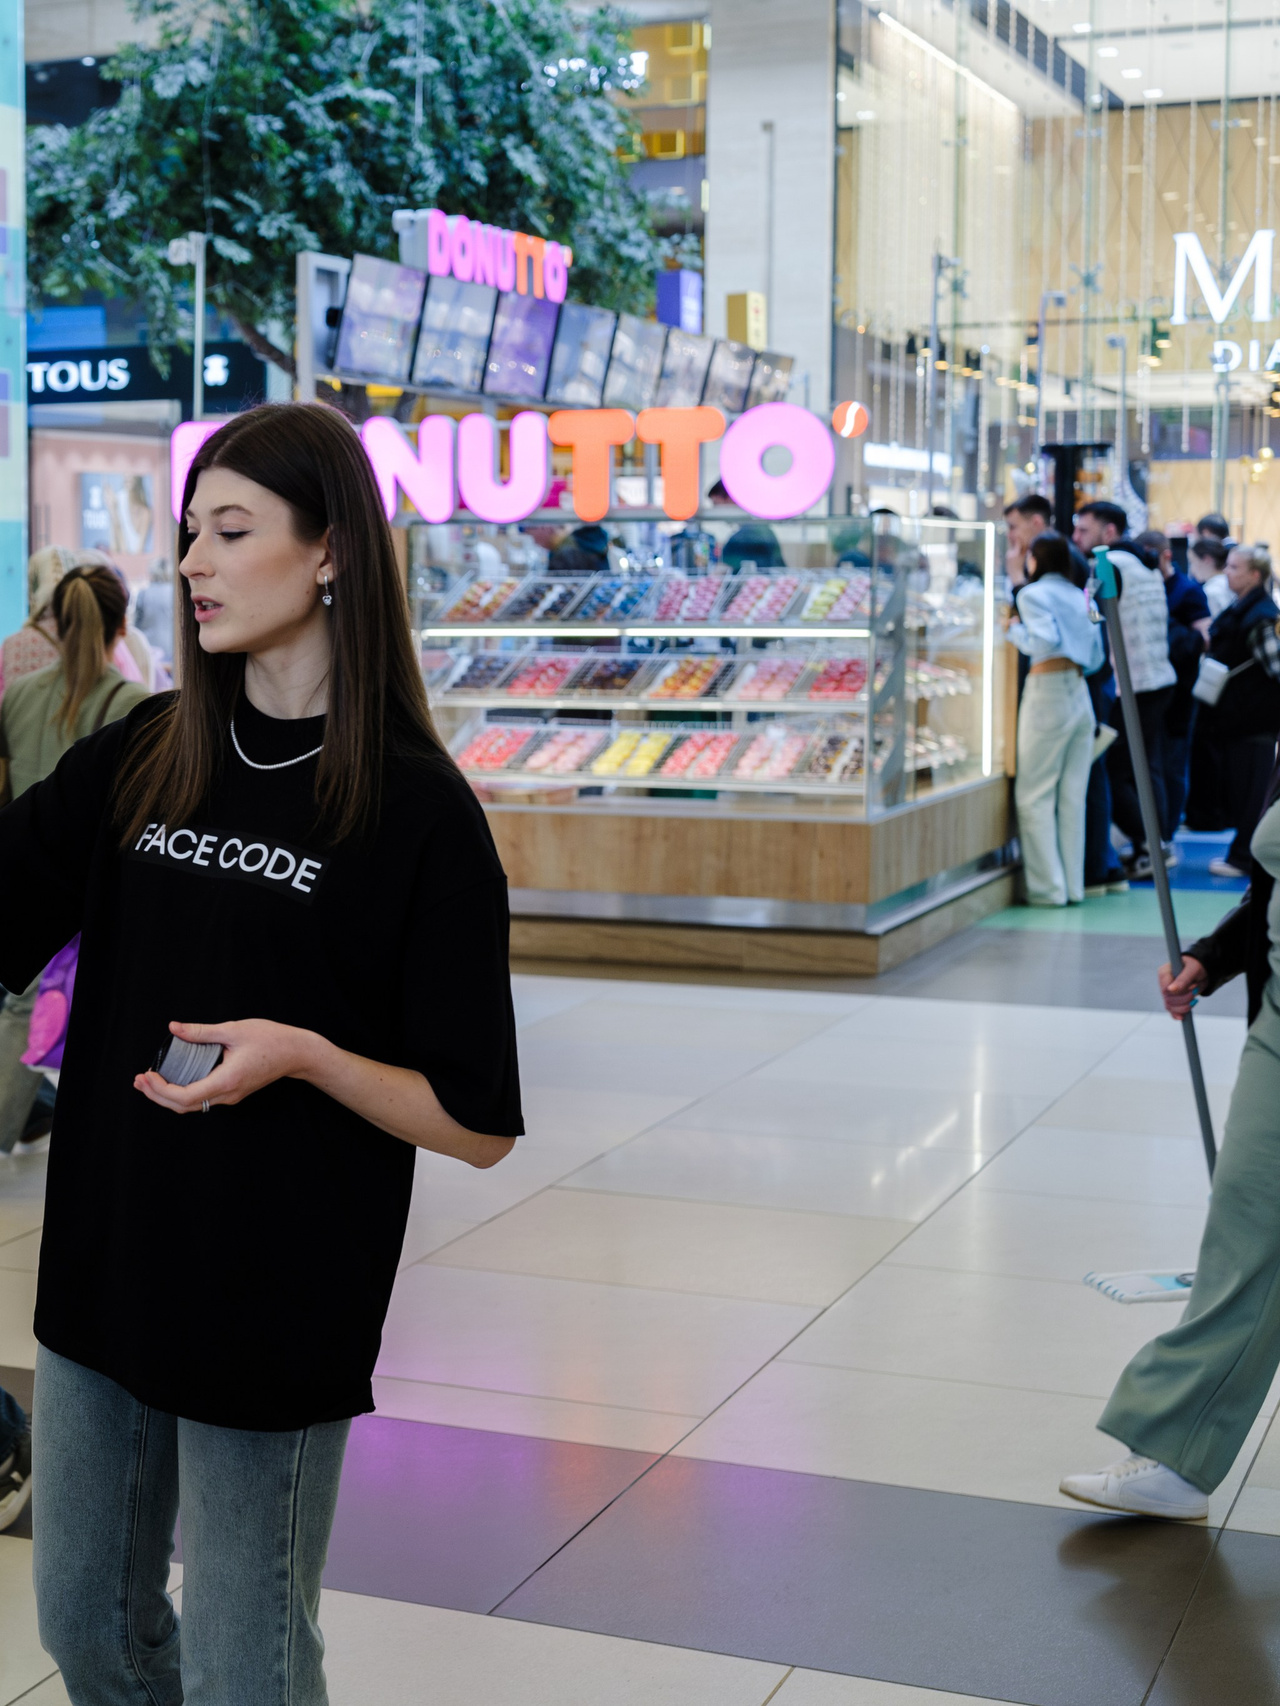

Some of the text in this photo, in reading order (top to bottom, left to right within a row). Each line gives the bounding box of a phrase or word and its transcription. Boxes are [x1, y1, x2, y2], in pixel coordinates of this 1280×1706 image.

[428, 208, 568, 303] DONUTTO
[26, 358, 131, 393] TOUS
[171, 402, 835, 524] NUTTO
[134, 823, 322, 893] FACE CODE
